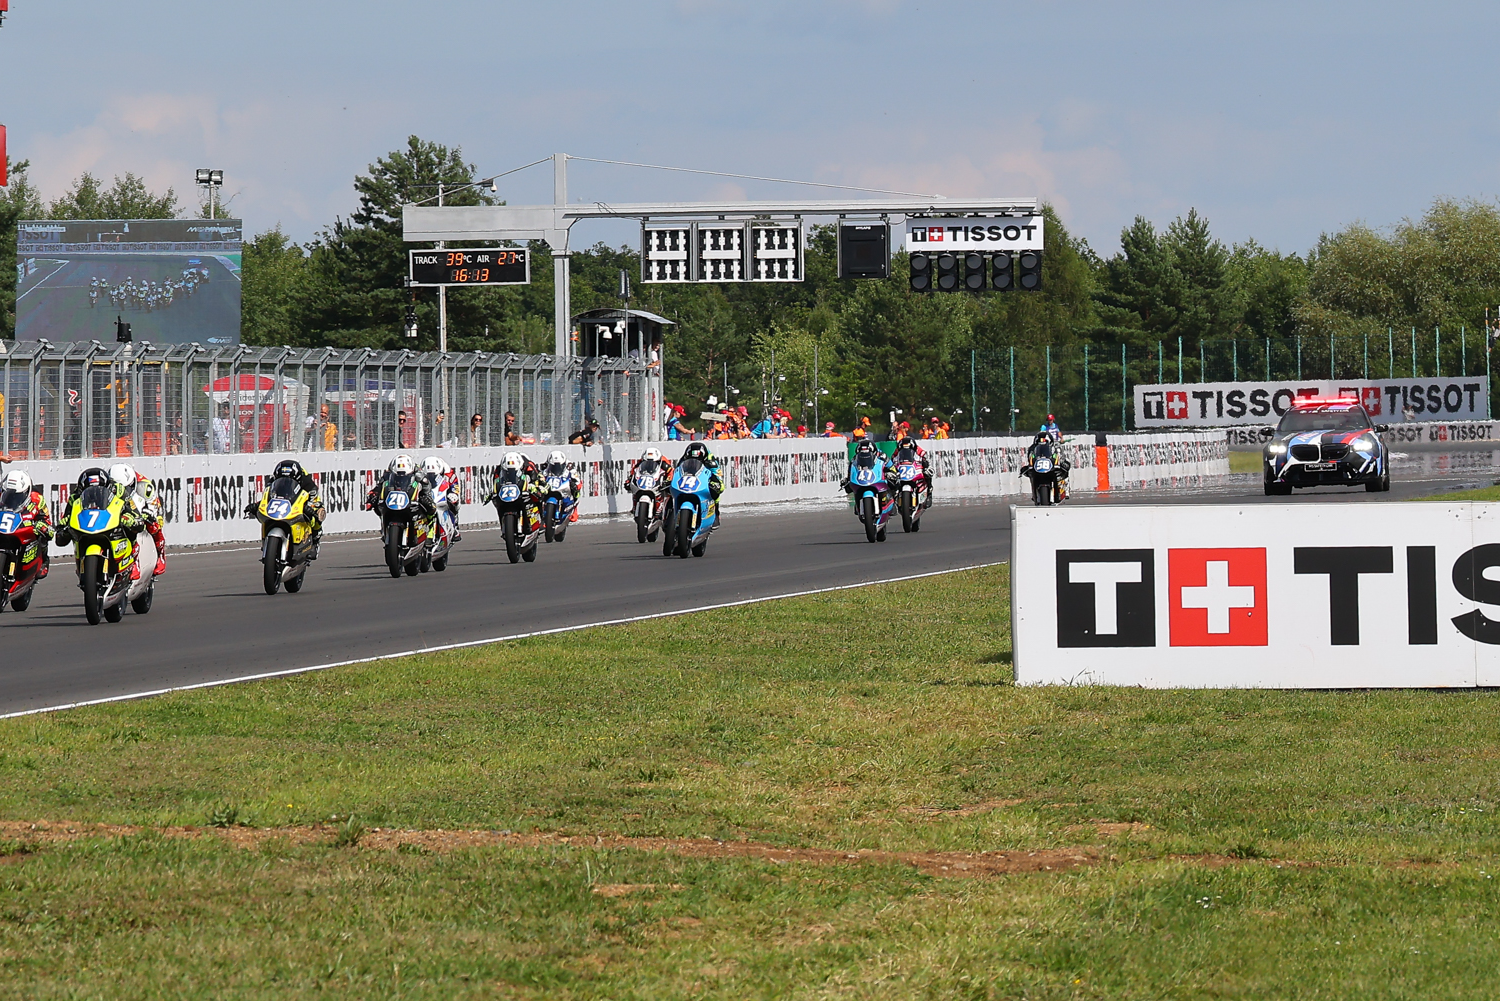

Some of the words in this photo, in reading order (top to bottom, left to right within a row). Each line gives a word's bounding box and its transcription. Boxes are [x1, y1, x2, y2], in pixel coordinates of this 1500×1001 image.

[947, 225, 1037, 242] TISSOT
[414, 256, 438, 264] TRACK
[477, 255, 490, 263] AIR
[454, 268, 489, 282] 16:13
[1385, 384, 1481, 415] TISSOT
[1227, 427, 1273, 445] TISSO
[1447, 425, 1493, 441] TISSOT
[857, 469, 873, 481] 47
[900, 466, 915, 478] 24
[680, 476, 696, 488] 14
[204, 475, 243, 521] TISSOT
[321, 470, 355, 514] TISSOT
[389, 493, 406, 506] 20
[501, 486, 518, 499] 23
[268, 501, 289, 516] 54
[0, 512, 16, 533] 5
[87, 511, 100, 527] 7
